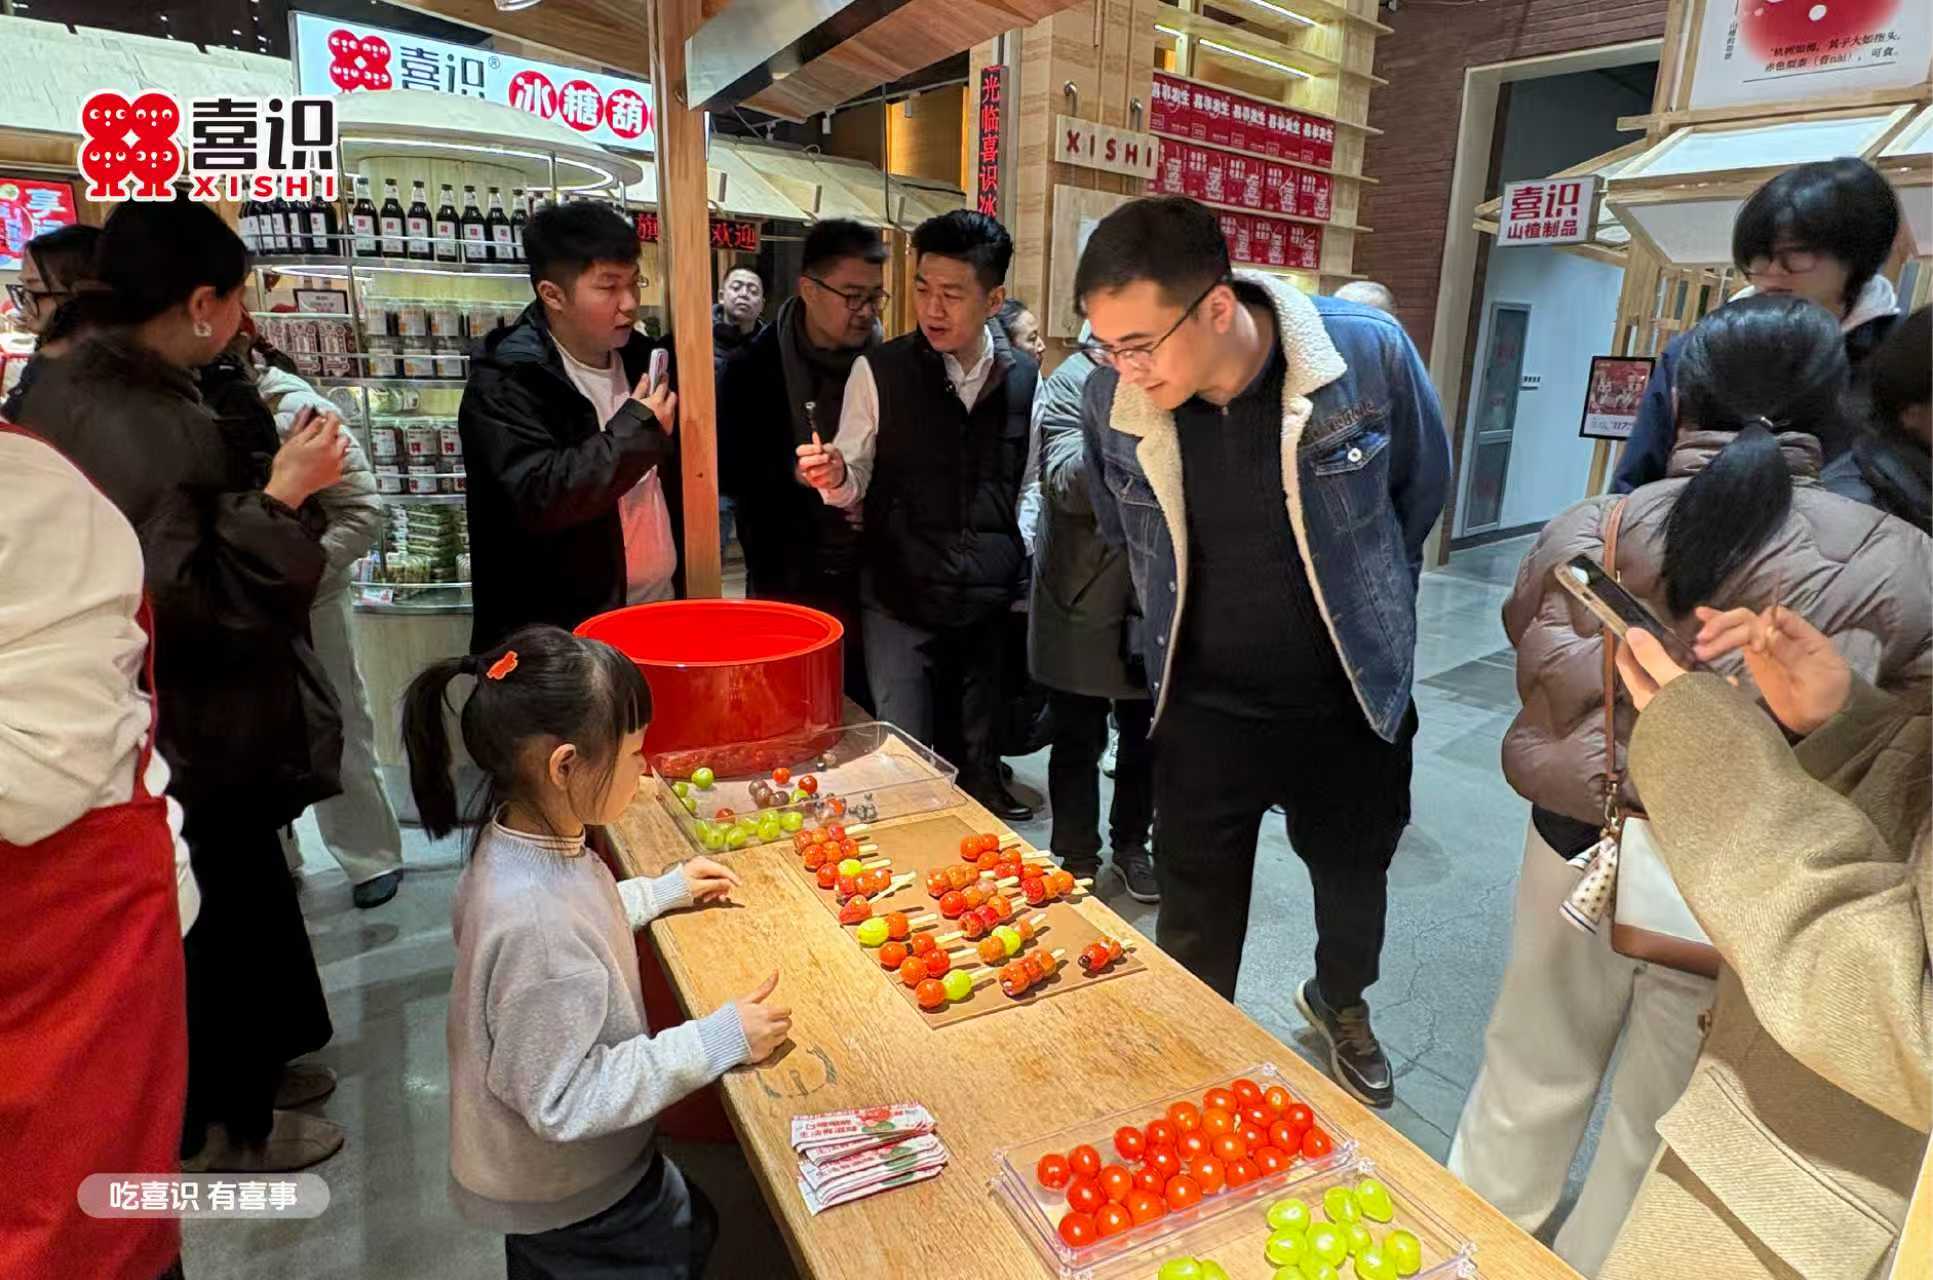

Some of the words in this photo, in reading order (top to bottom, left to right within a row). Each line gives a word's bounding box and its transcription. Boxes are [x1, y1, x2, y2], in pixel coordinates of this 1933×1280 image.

[514, 77, 645, 135] 冰糖葫
[978, 66, 1001, 218] 光临喜识冰
[1066, 129, 1152, 168] XISHI
[1510, 183, 1581, 220] 喜识
[1507, 220, 1578, 240] 山楂制品
